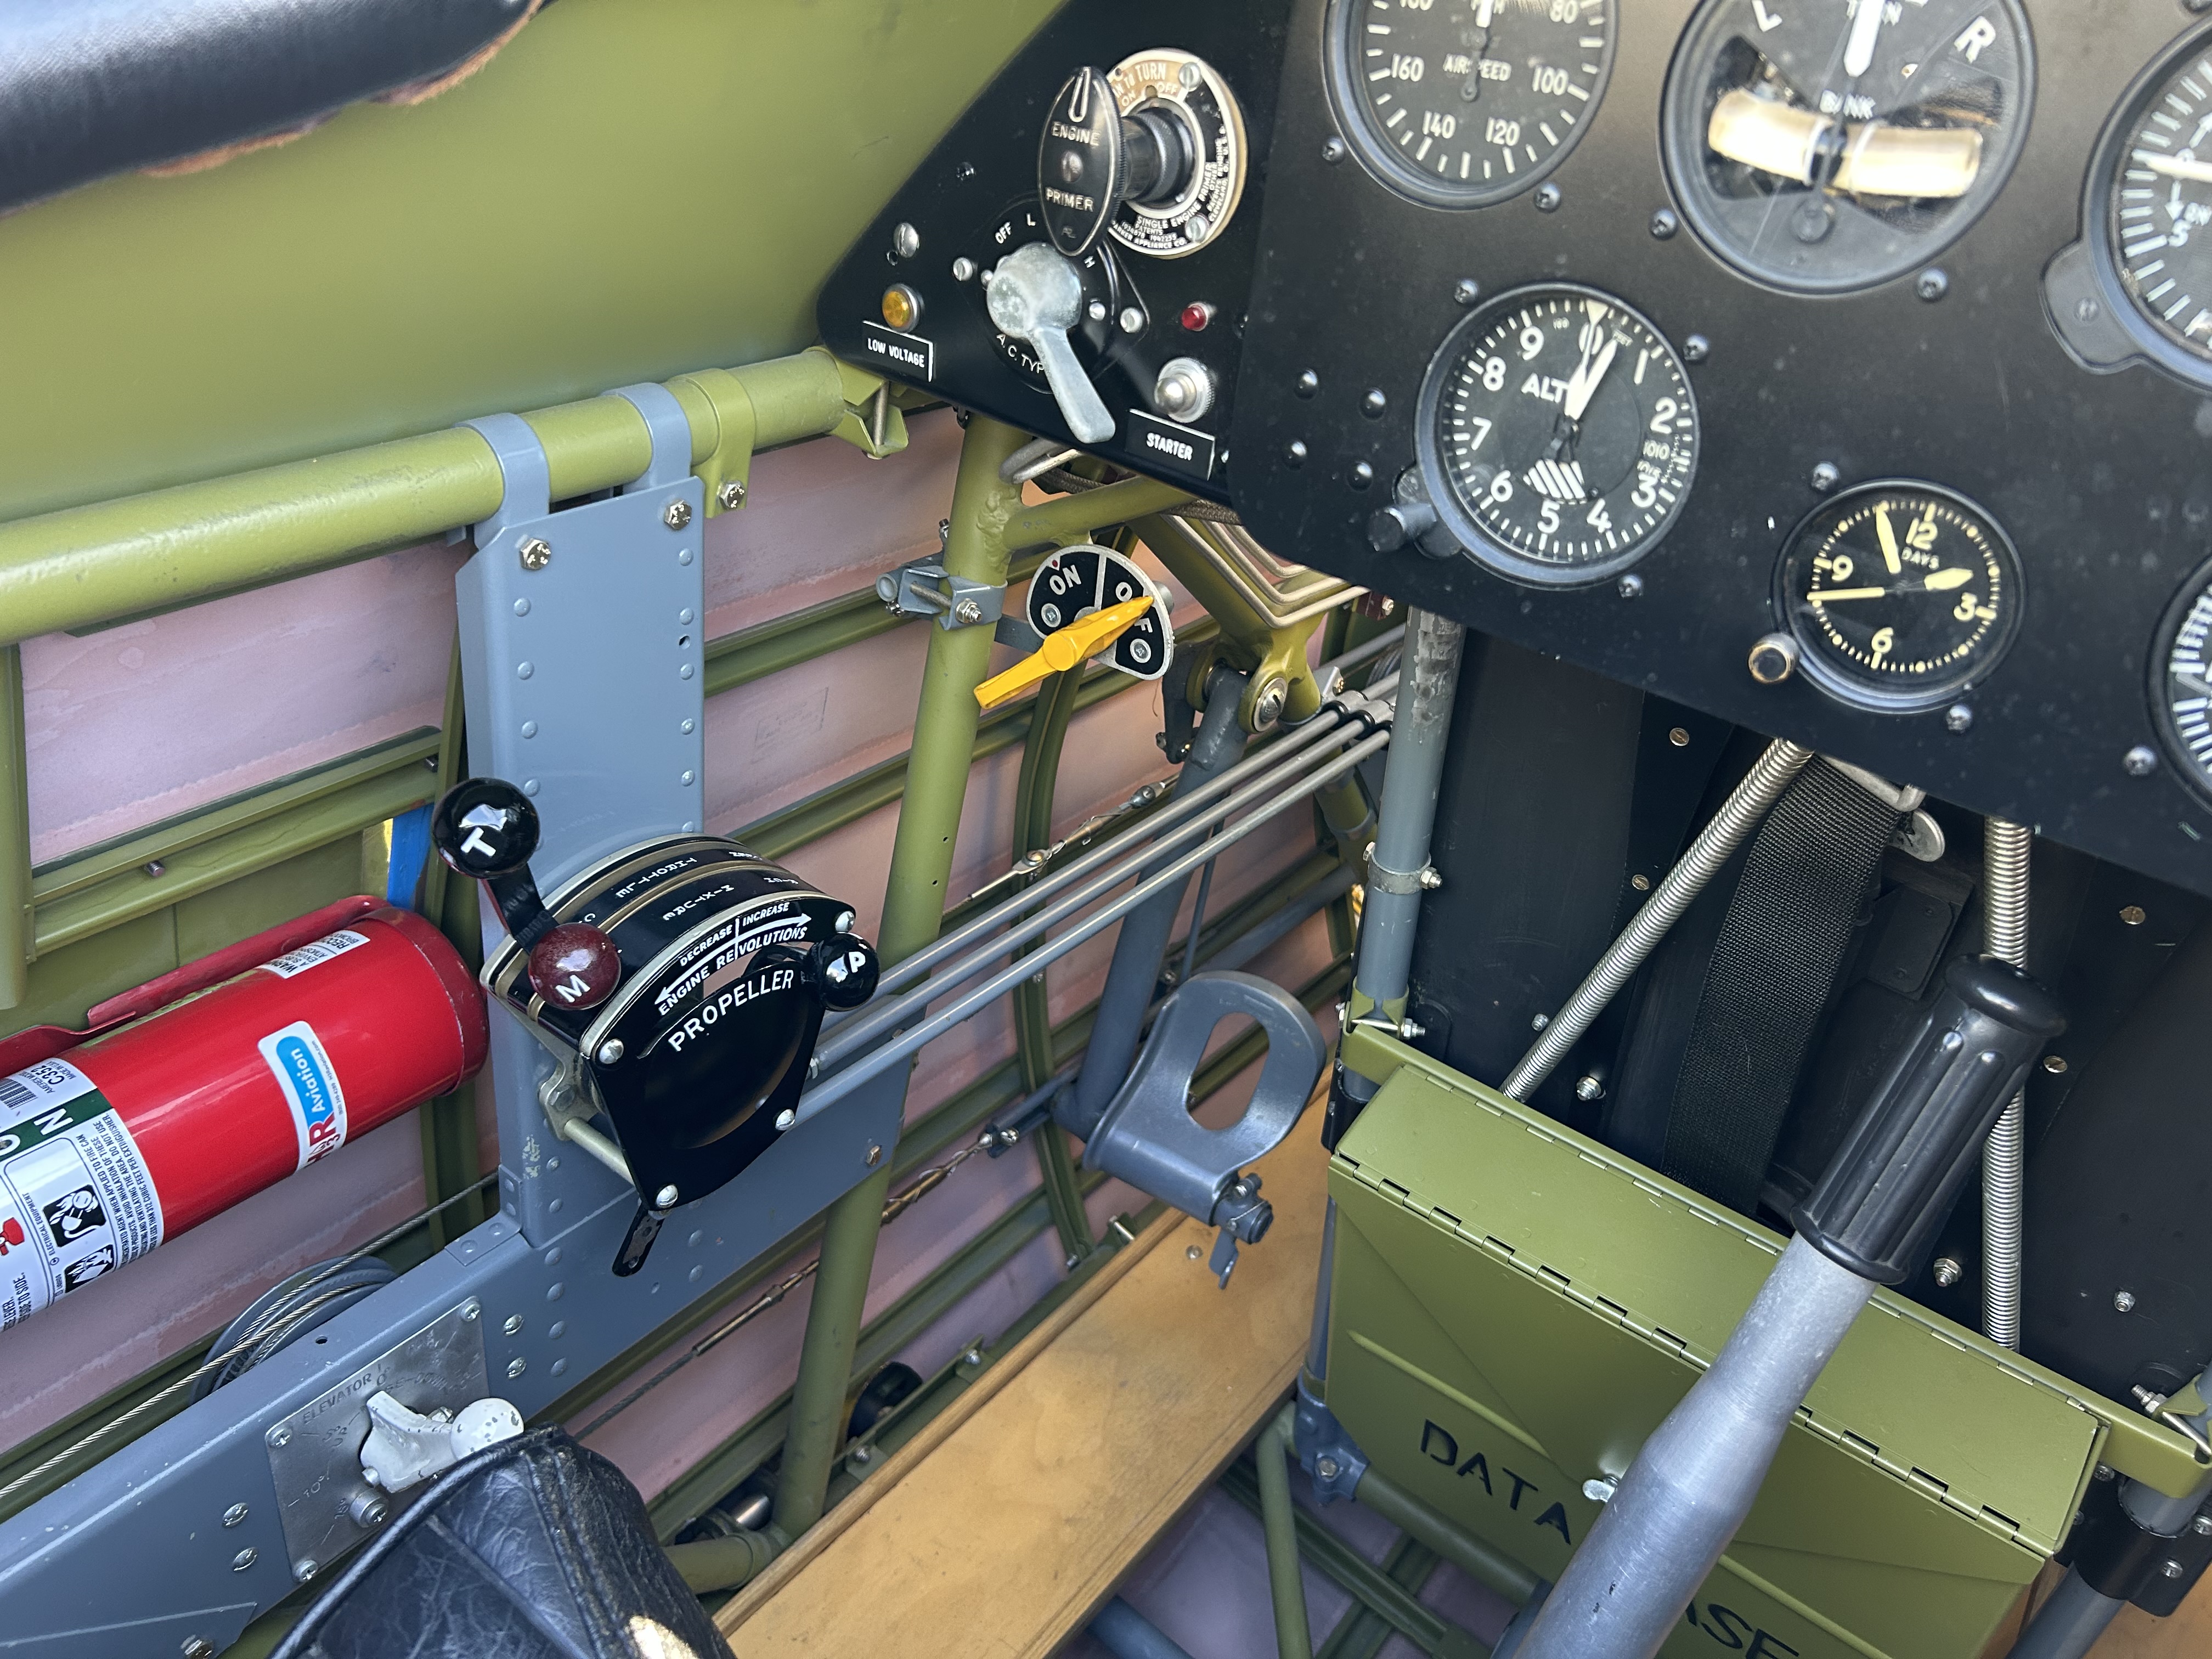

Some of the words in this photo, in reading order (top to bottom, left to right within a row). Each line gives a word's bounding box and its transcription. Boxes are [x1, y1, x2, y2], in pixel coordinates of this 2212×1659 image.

[1751, 0, 1782, 32] L
[1955, 16, 1995, 63] R
[1124, 73, 1136, 89] TO
[1135, 63, 1167, 82] TURN
[1391, 53, 1425, 82] 160
[1443, 53, 1511, 81] AIREED
[1533, 65, 1568, 95] 100
[1121, 91, 1136, 107] ON
[1156, 82, 1178, 94] OFF
[1051, 121, 1101, 146] ENGINE
[1423, 111, 1455, 138] 140
[1486, 117, 1520, 146] 120
[1045, 187, 1094, 212] PRIMER
[1137, 215, 1169, 229] SINGLE
[1170, 201, 1202, 227] ENGINE
[1198, 162, 1212, 201] PRIMER
[995, 221, 1012, 244] OFF
[1026, 212, 1036, 226] L
[1135, 223, 1164, 235] PATENTS
[1134, 237, 1172, 249] APPLIANCE
[867, 338, 885, 356] LOW
[888, 343, 925, 368] VOLTAGE
[1520, 325, 1545, 360] 9
[1022, 353, 1044, 374] TYP
[1482, 356, 1506, 391] 8
[1634, 348, 1648, 385] 1
[1521, 373, 1569, 403] ALT
[1650, 397, 1678, 434] 2
[1147, 432, 1193, 461] STARTER
[1472, 417, 1492, 450] 7
[1490, 470, 1513, 503] 6
[1632, 472, 1658, 507] 3
[1537, 499, 1560, 533] 5
[1587, 499, 1612, 533] 4
[1905, 517, 1938, 551] 12
[1831, 555, 1853, 582] 9
[1901, 546, 1939, 571] DAYS
[1049, 565, 1082, 596] ON
[1115, 582, 1153, 633] OF
[1954, 592, 1978, 622] 3
[1872, 627, 1894, 654] 6
[460, 826, 496, 857] T
[616, 856, 697, 898] THROTTLE
[663, 884, 735, 922] MIXTURE
[742, 902, 791, 927] INCREASE
[680, 925, 732, 967] DECREASE
[658, 966, 710, 1016] ENGINE
[716, 926, 808, 970] REVOLUTIONS
[849, 950, 866, 973] P
[555, 975, 591, 1003] M
[668, 969, 794, 1052] PROPELLER
[31, 1065, 65, 1085] C352
[31, 1077, 55, 1093] AMEREX
[59, 1068, 76, 1080] MADE
[291, 1048, 325, 1113] Aviation
[76, 1134, 89, 1147] CAN
[93, 1121, 106, 1133] USE
[101, 1133, 114, 1147] NOT
[102, 1113, 132, 1158] EXTINGUISHER.
[83, 1147, 98, 1162] FIRE
[91, 1137, 105, 1157] THESE
[109, 1146, 119, 1156] DO
[93, 1161, 102, 1171] TO
[102, 1157, 112, 1166] OF
[116, 1156, 129, 1175] AREA.
[127, 1156, 138, 1170] PER
[98, 1171, 115, 1196] APPLIED
[107, 1166, 128, 1201] INHALATION
[123, 1174, 134, 1188] THE
[133, 1170, 145, 1185] FEET
[109, 1196, 121, 1215] WHEN
[128, 1187, 145, 1222] VENTILATING
[139, 1184, 151, 1203] CUBIC
[22, 1193, 42, 1225] EQUIPMENT
[123, 1201, 134, 1219] AVOID
[145, 1202, 154, 1213] 312
[148, 1211, 157, 1227] THAN
[115, 1214, 126, 1232] AGENT
[39, 1224, 55, 1256] ELECTRICAL
[13, 1272, 29, 1295] SIDE.
[303, 1373, 371, 1424] ELEVATOR
[1419, 1419, 1571, 1545] DATA
